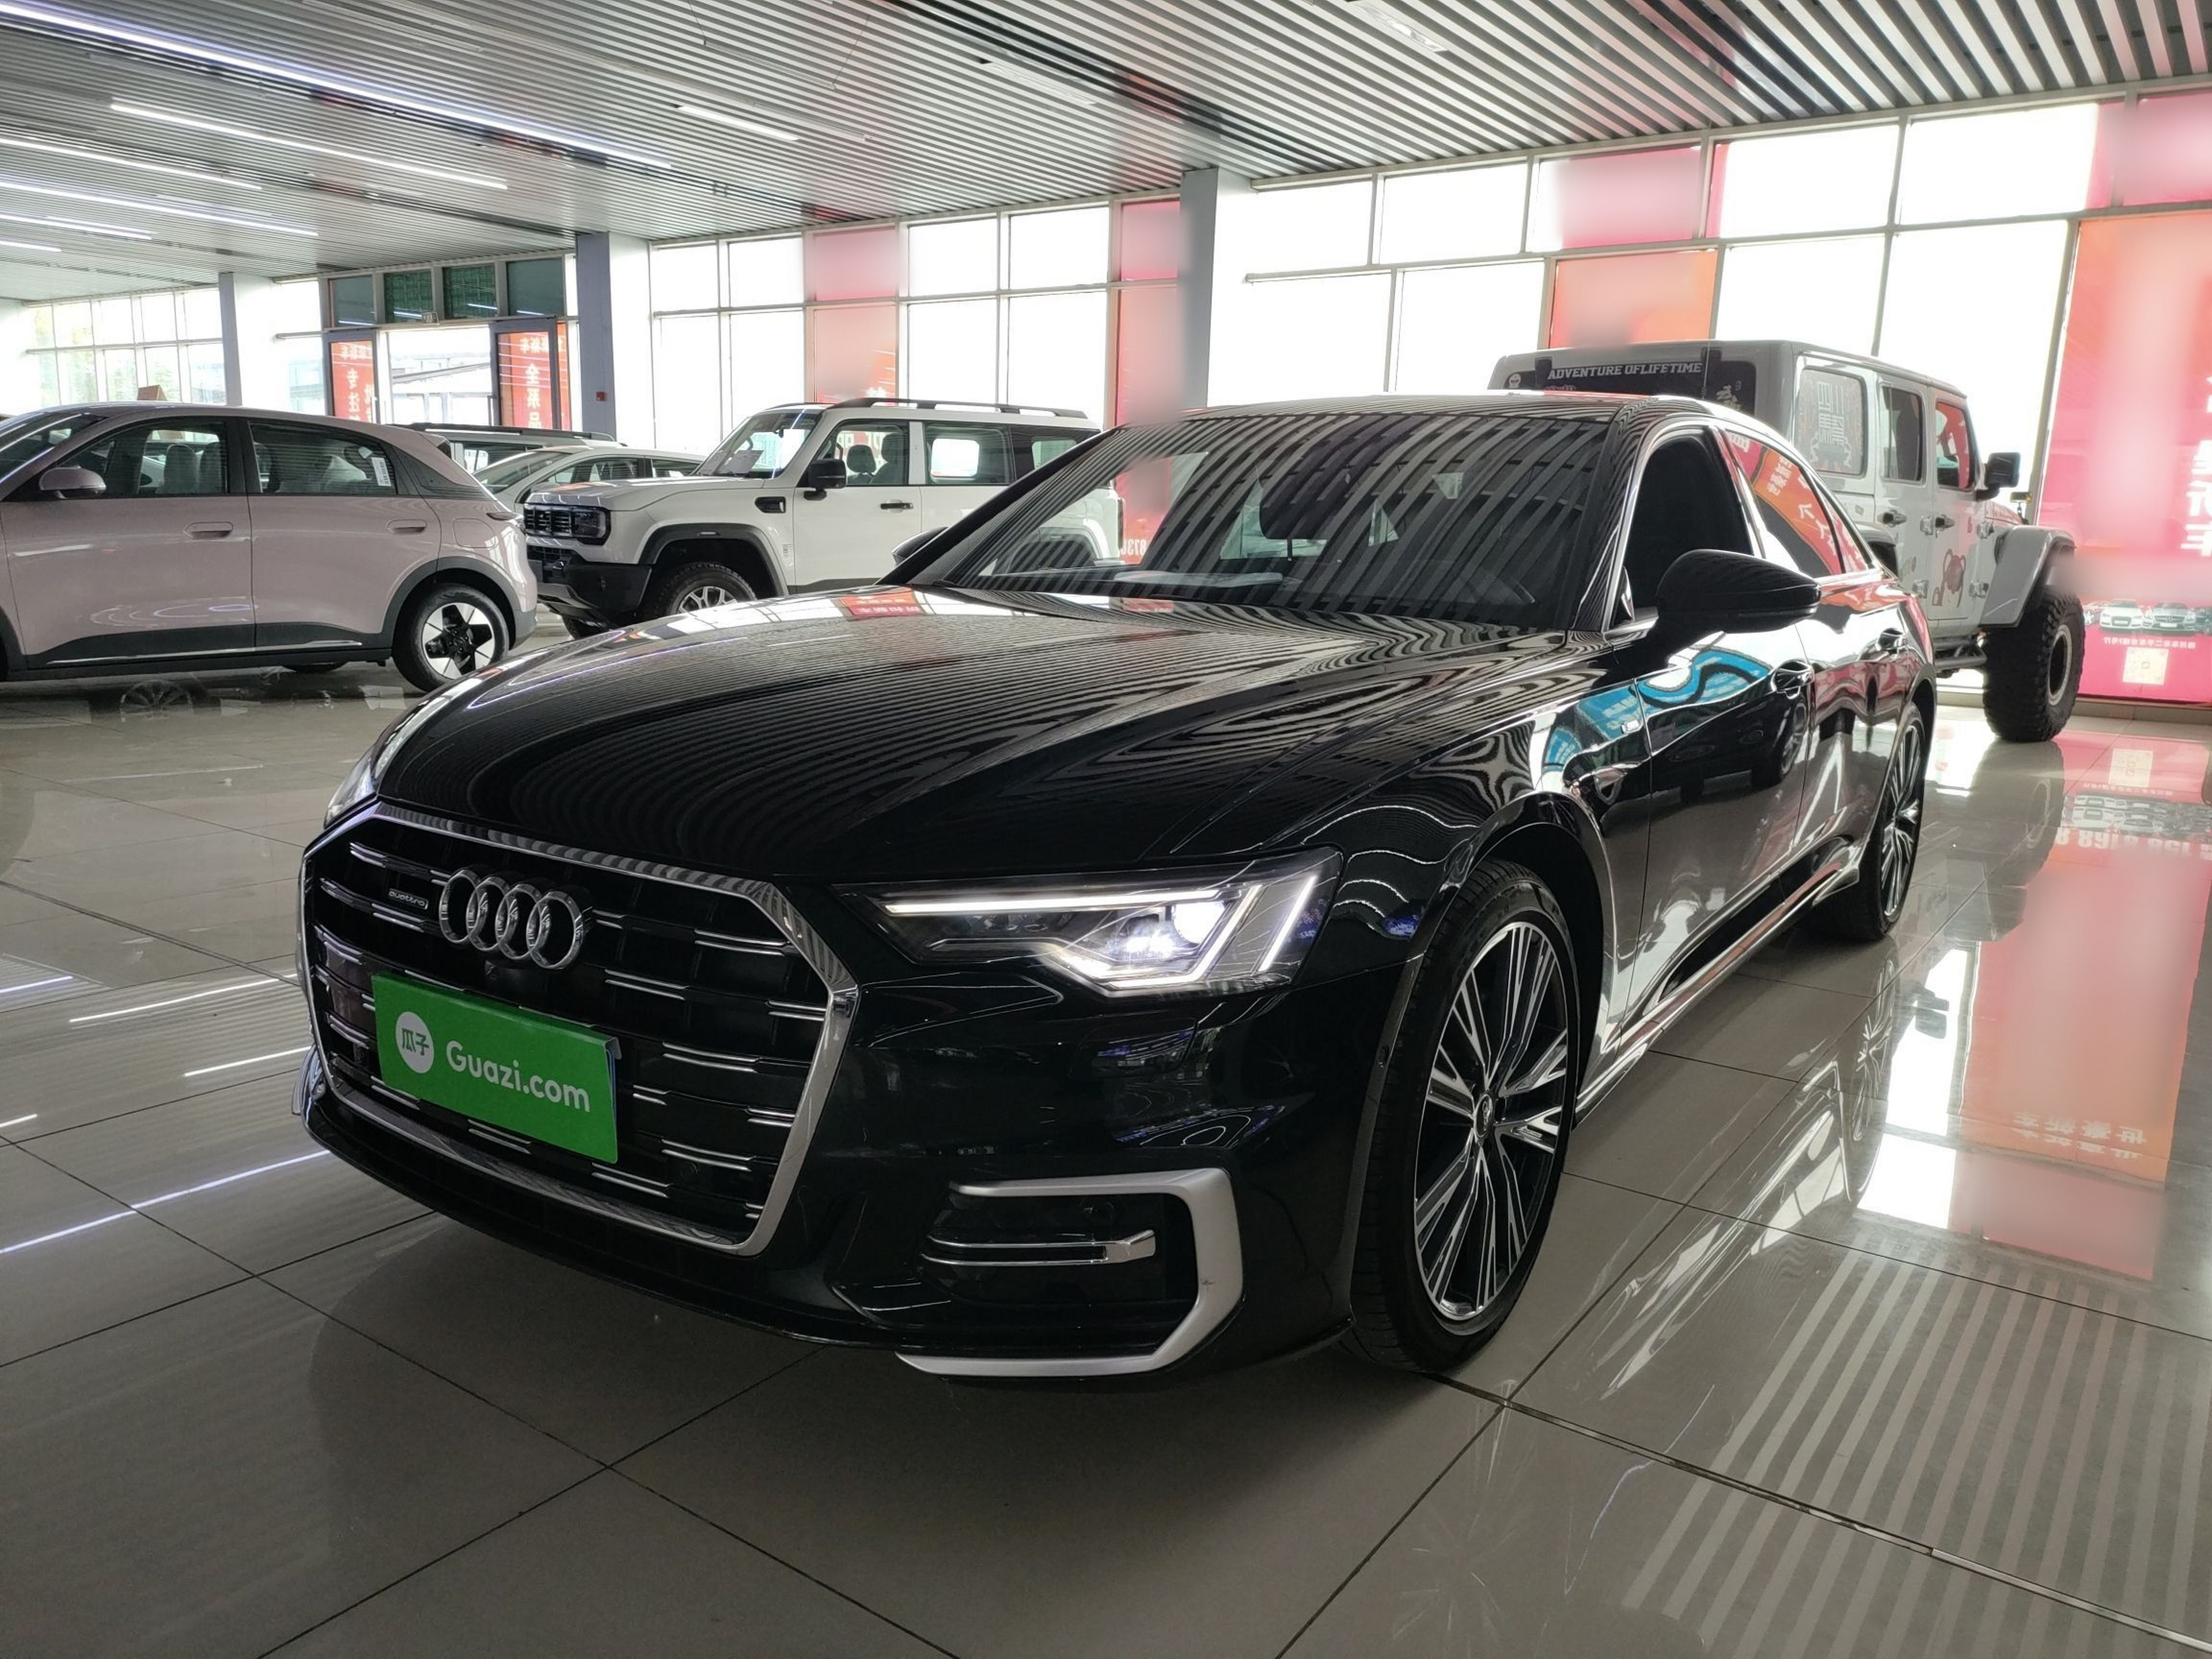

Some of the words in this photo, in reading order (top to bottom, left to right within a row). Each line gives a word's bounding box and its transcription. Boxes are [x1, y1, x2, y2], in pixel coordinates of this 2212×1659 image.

[1547, 365, 1622, 380] ADVENTURE
[388, 891, 426, 906] quattro
[401, 1027, 430, 1056] 瓜子
[446, 1040, 590, 1113] Guazi.com
